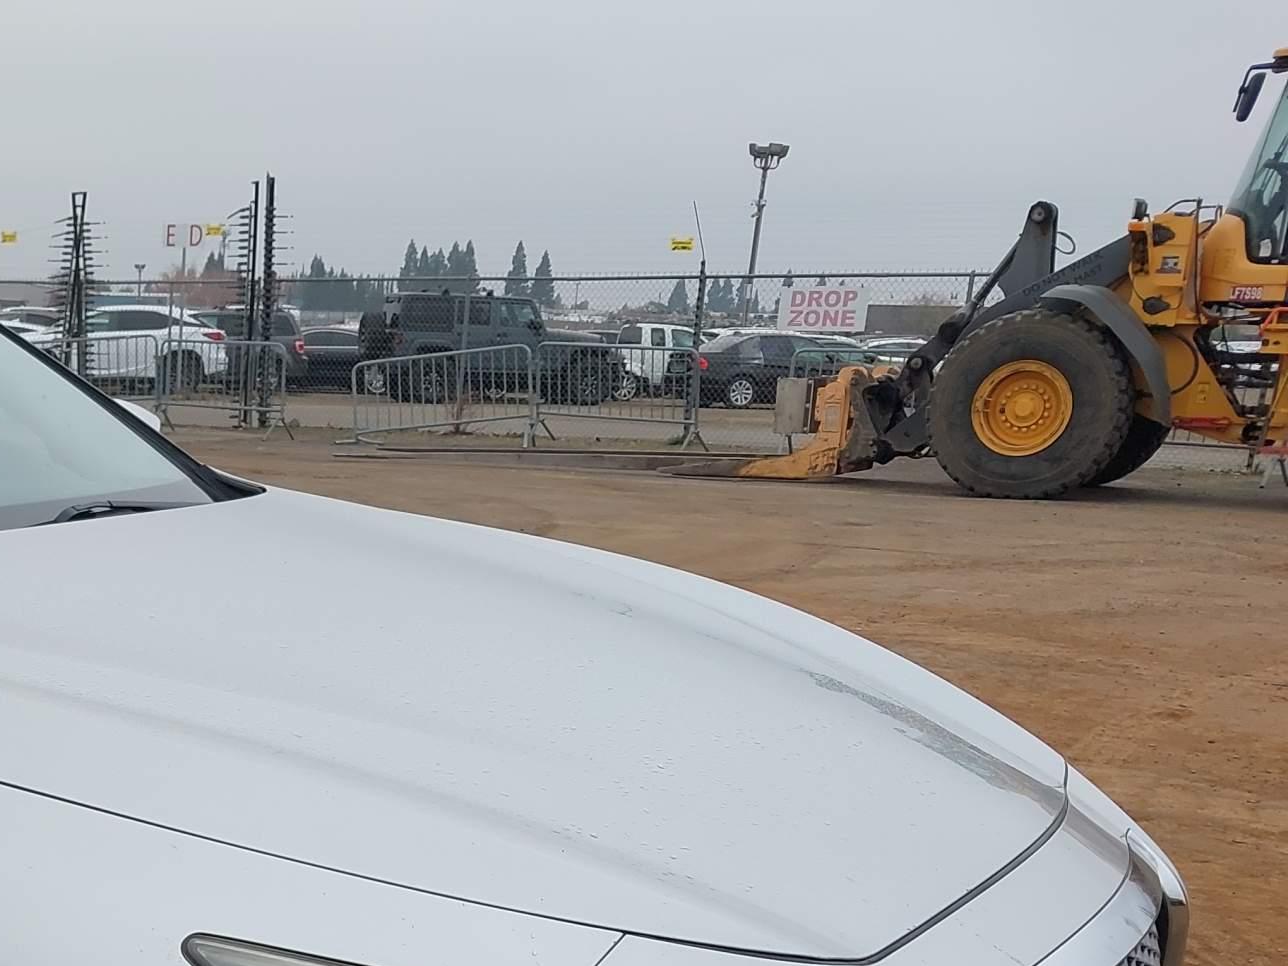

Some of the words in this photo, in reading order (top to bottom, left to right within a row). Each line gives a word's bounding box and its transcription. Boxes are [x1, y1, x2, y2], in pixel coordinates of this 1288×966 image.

[166, 224, 177, 247] E
[189, 224, 203, 247] D
[790, 290, 858, 308] DROP
[787, 309, 857, 327] ZONE
